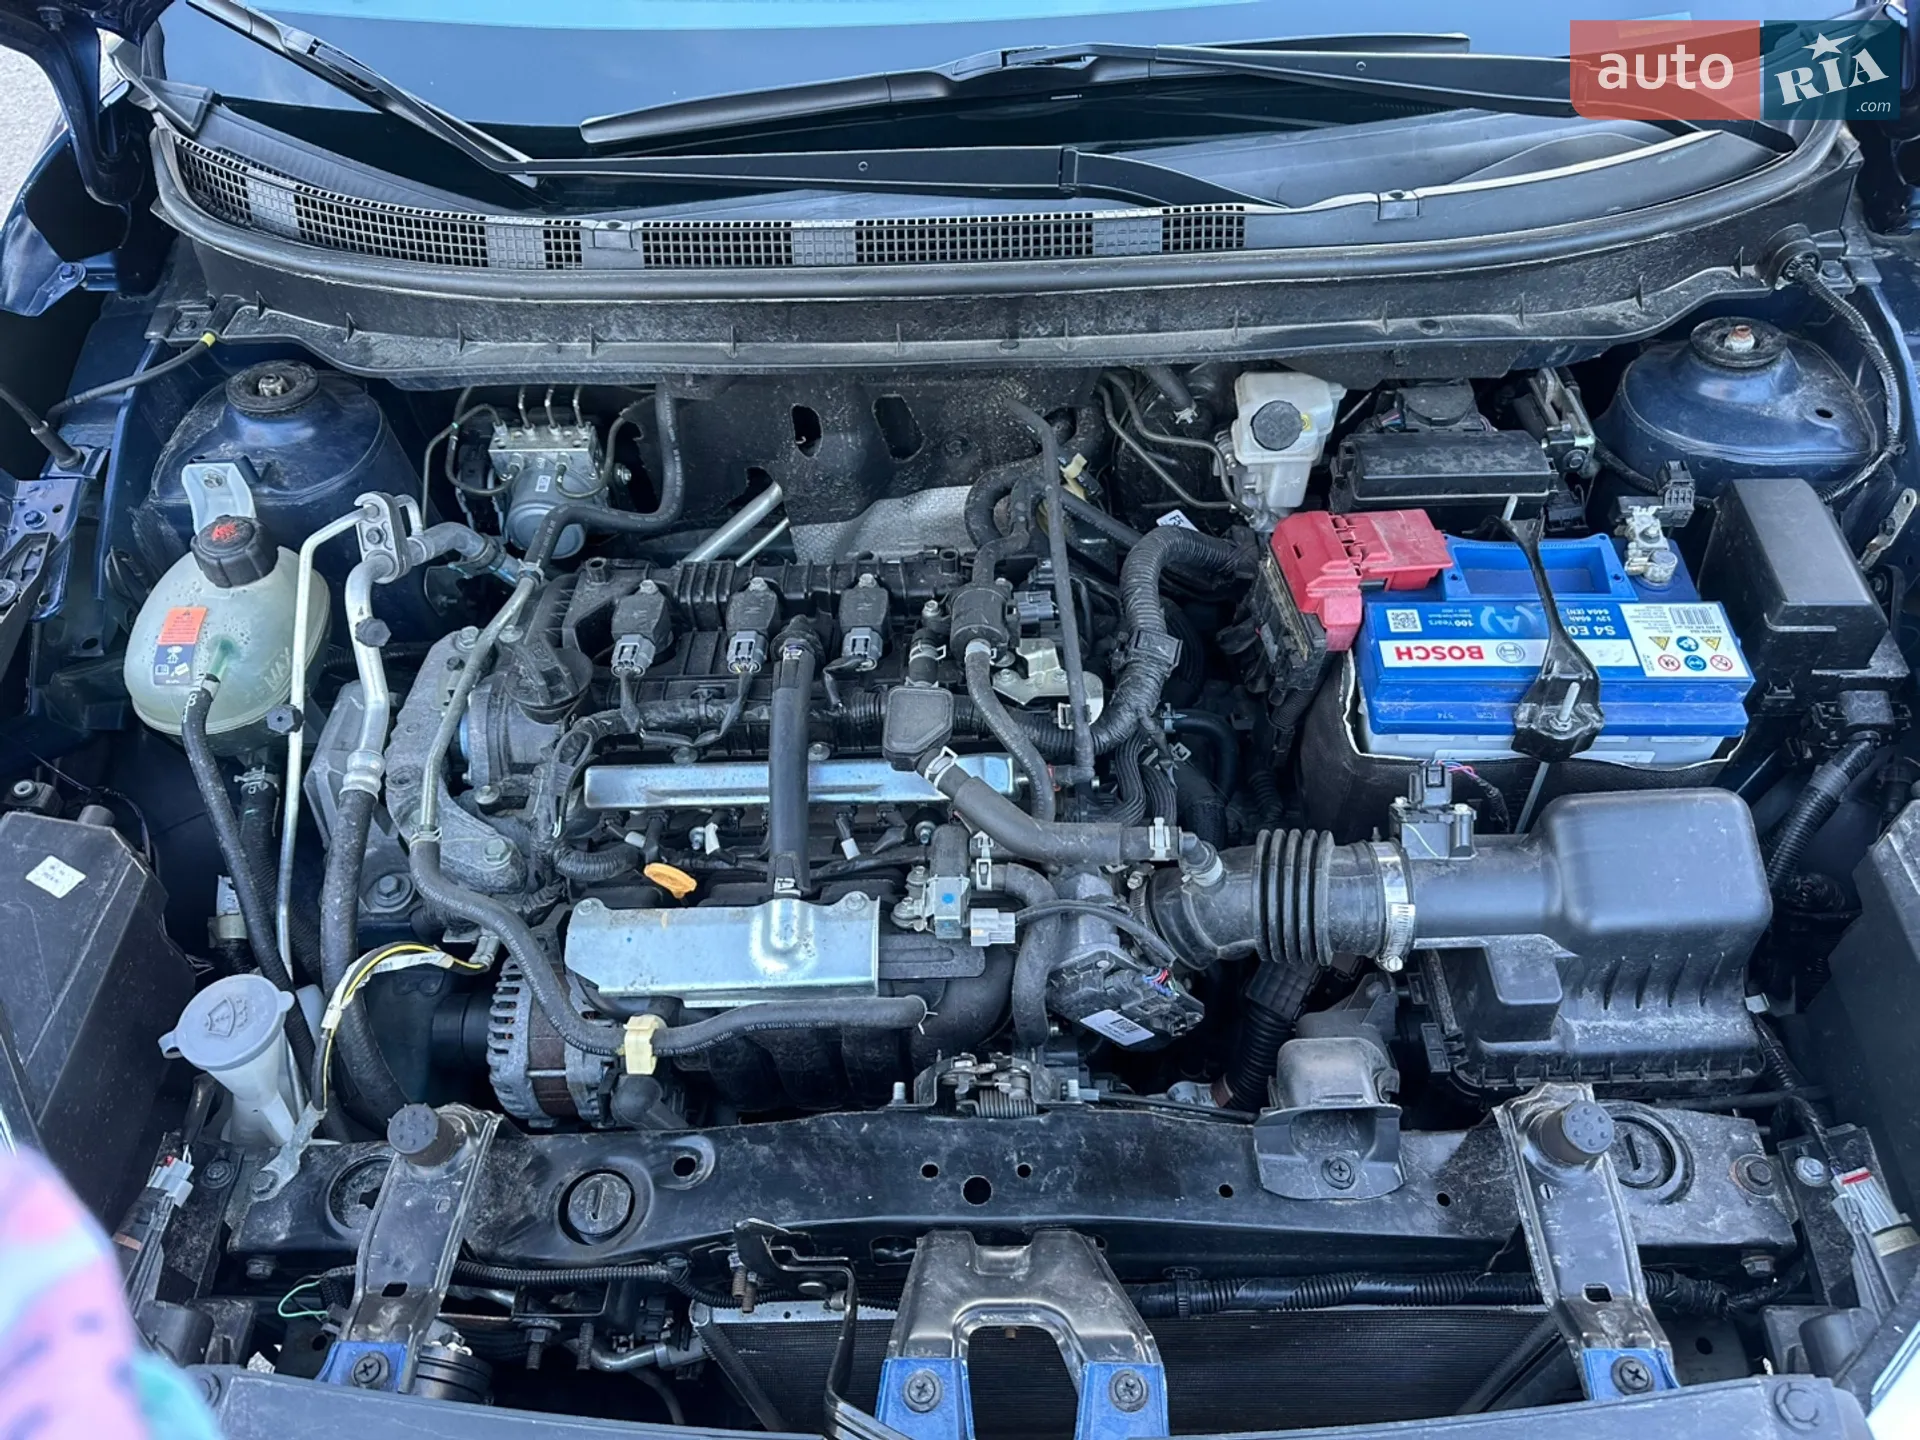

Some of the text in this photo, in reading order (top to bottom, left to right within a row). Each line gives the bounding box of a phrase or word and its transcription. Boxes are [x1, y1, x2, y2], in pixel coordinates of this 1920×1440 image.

[1428, 619, 1475, 627] 100 Years
[1593, 625, 1616, 636] S4
[1395, 645, 1484, 661] BOSCH
